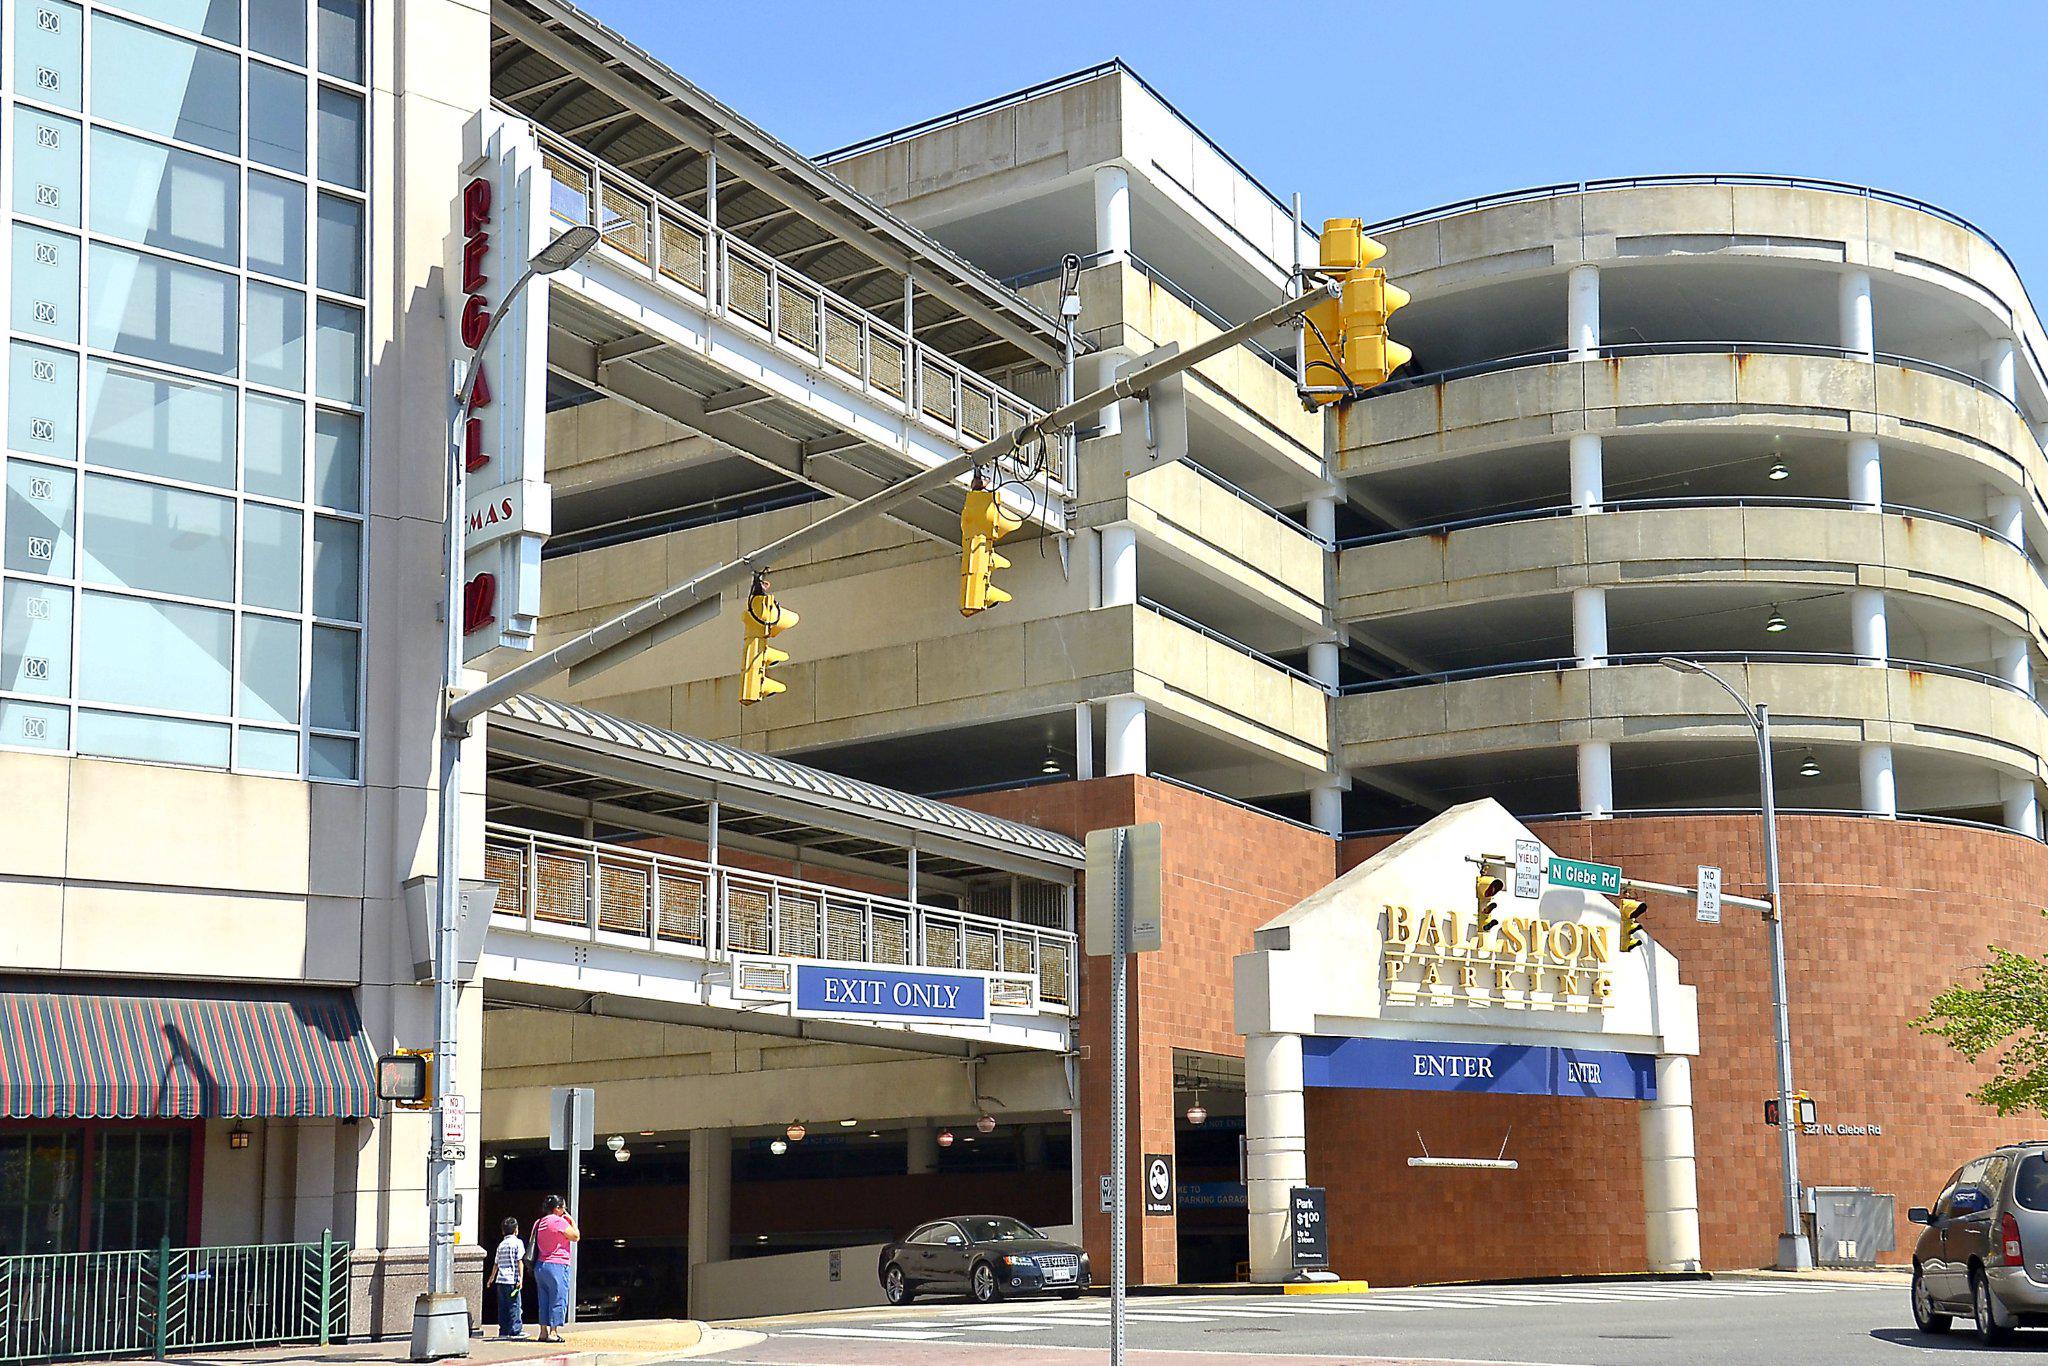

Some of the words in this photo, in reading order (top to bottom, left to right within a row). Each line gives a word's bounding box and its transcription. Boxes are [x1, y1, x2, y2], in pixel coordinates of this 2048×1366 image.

[461, 177, 491, 474] REGAL
[1519, 853, 1538, 864] YIELD
[1553, 864, 1562, 879] N
[1566, 866, 1597, 885] Glebe
[1601, 872, 1617, 888] Rd
[1704, 870, 1715, 880] NO
[1702, 881, 1717, 890] TURN
[1705, 891, 1713, 899] ON
[1703, 901, 1715, 909] RED
[1383, 904, 1612, 963] BALLSTON
[1385, 959, 1612, 999] PARKING
[824, 977, 887, 1005] EXIT
[893, 982, 961, 1009] ONLY
[1413, 1054, 1494, 1078] ENTER
[1567, 1062, 1602, 1084] ENTER
[450, 1097, 459, 1107] NO
[1823, 1124, 1835, 1134] N.
[1837, 1123, 1866, 1135] Glebe
[1867, 1124, 1881, 1134] Rd
[1179, 1196, 1214, 1205] PARKING
[1296, 1198, 1314, 1209] Park
